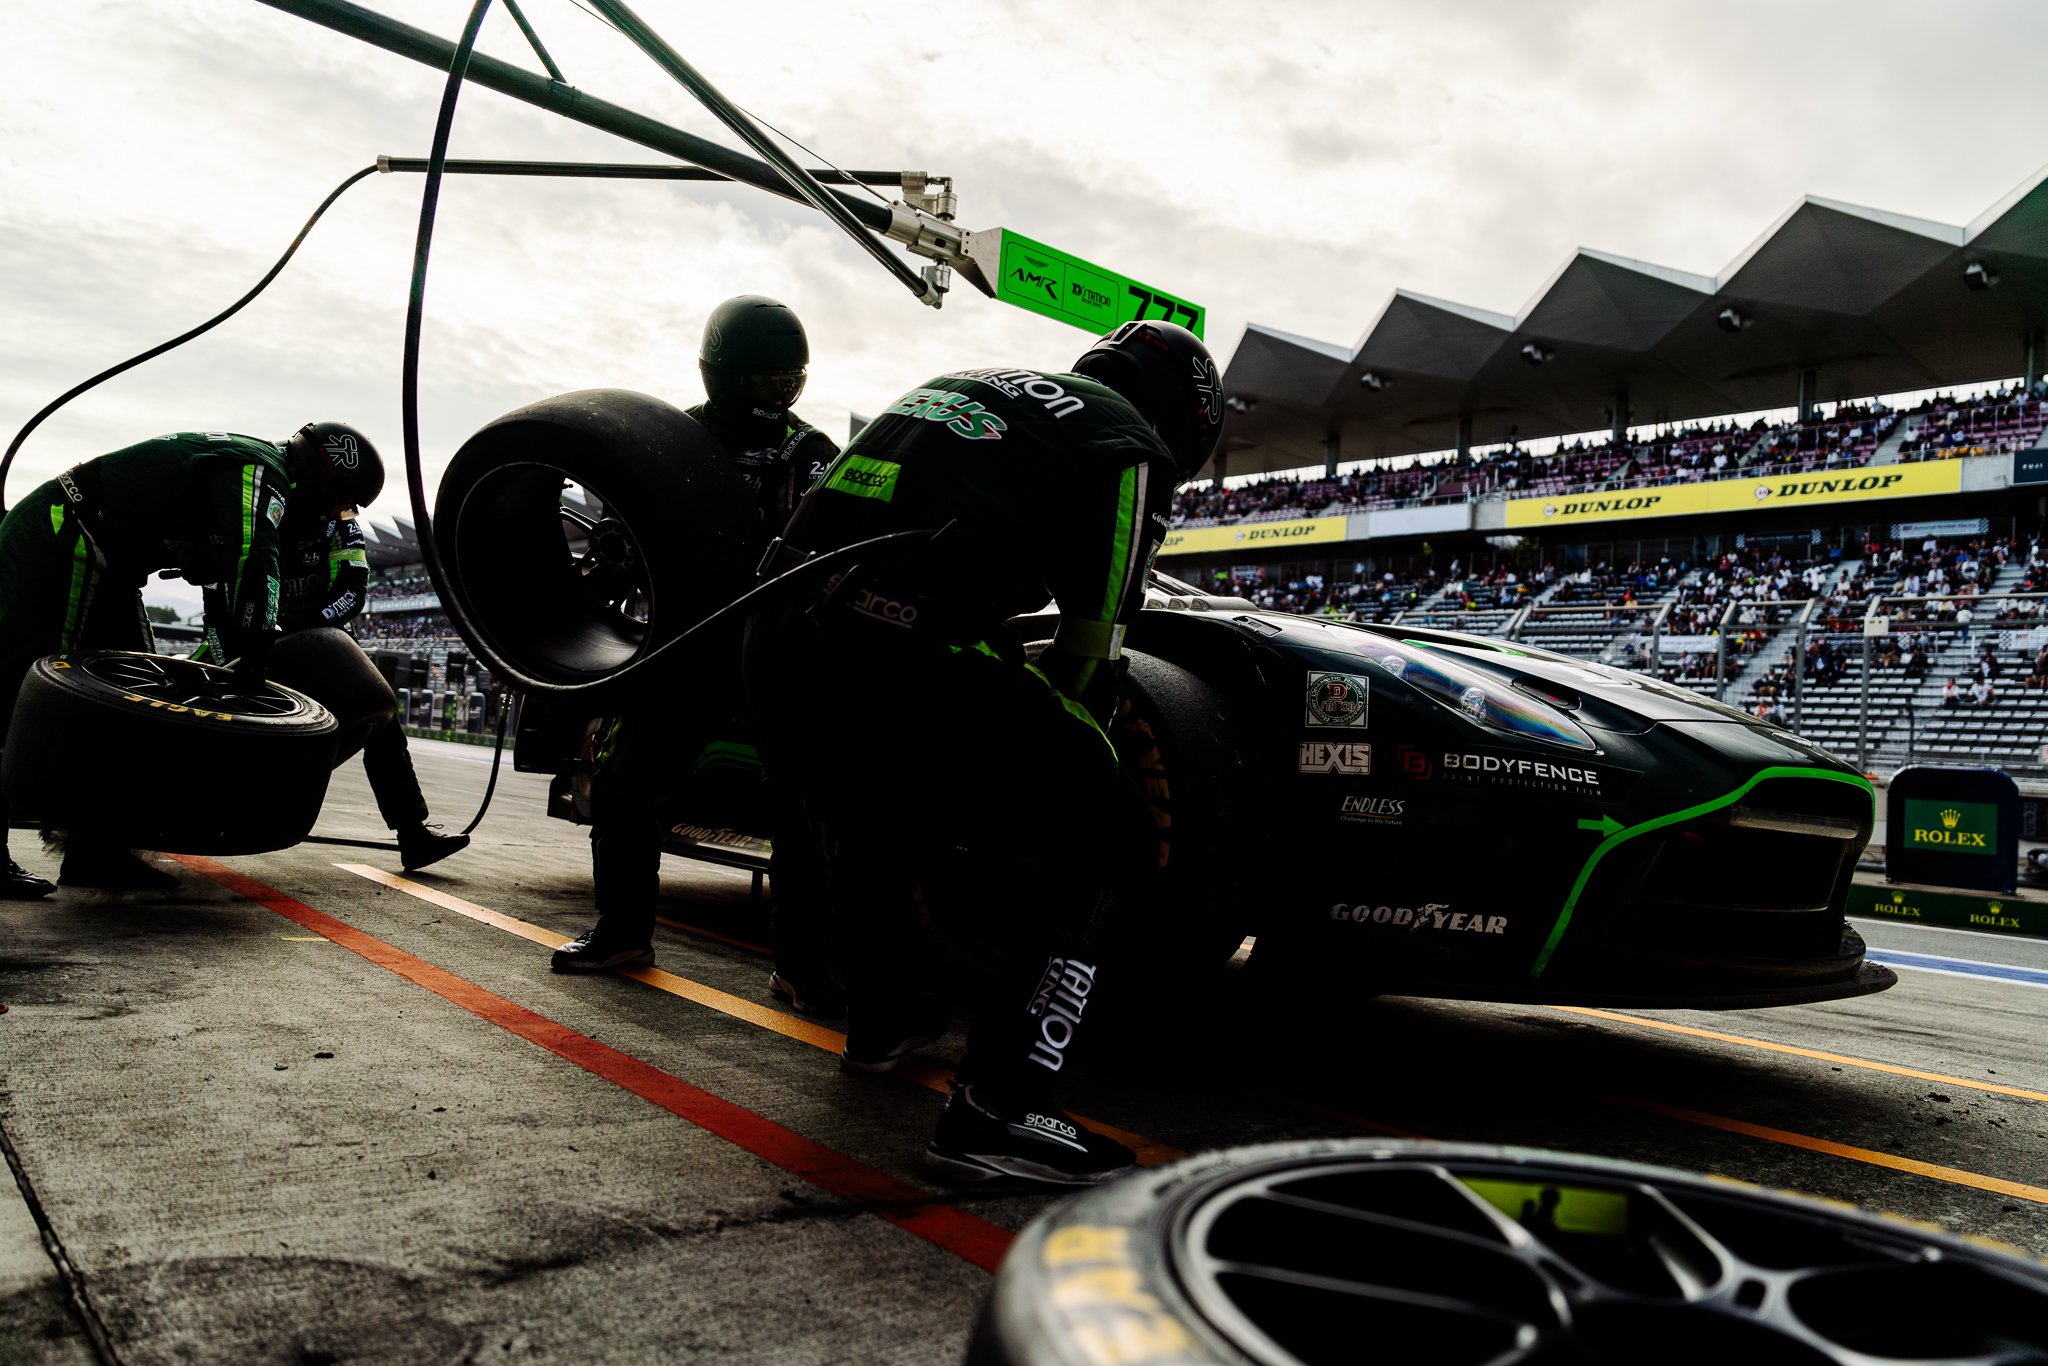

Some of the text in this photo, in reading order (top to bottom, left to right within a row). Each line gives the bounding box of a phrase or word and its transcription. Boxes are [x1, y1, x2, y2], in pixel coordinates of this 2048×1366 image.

[1010, 267, 1058, 300] AMR
[1128, 284, 1198, 333] 777
[883, 388, 1008, 440] EXUS
[842, 467, 888, 488] sparco
[1777, 474, 1902, 498] DUNLOP
[1561, 496, 1662, 515] DUNLOP
[1248, 525, 1316, 541] DUNLOP
[846, 588, 918, 629] arco
[1300, 743, 1371, 773] HEXIS
[1444, 752, 1600, 785] BODYFENCE
[1341, 796, 1406, 815] ENDLESS
[671, 823, 753, 848] GOODYEAR
[1914, 828, 1986, 847] ROLEX
[1330, 903, 1508, 934] GOODYEAR
[1874, 903, 1921, 918] ROLEX
[1970, 913, 2020, 928] ROLEX
[1024, 1112, 1078, 1140] sparco
